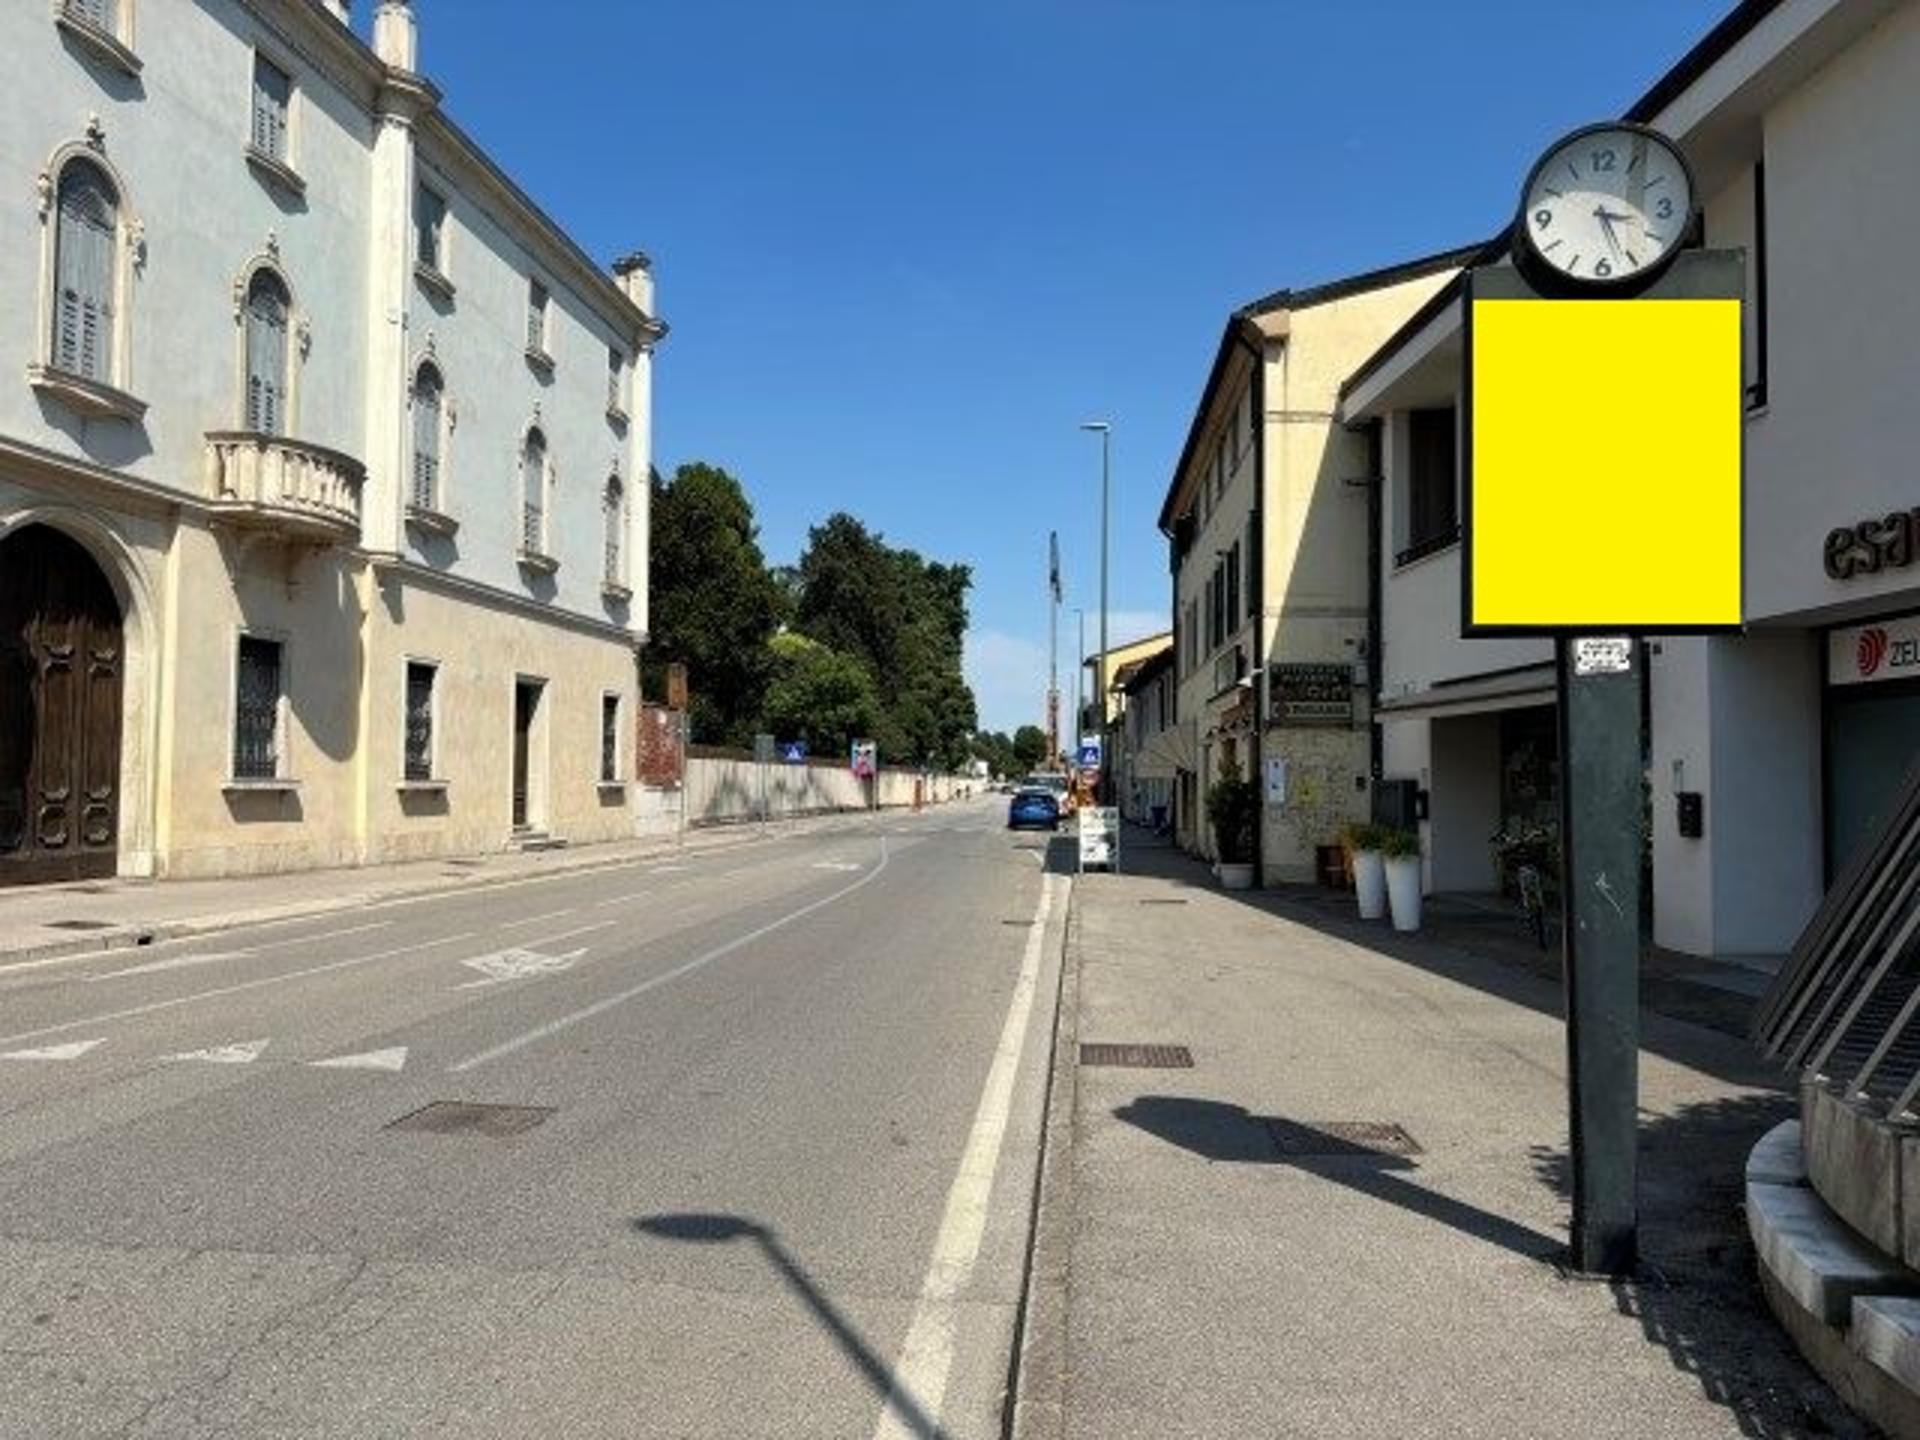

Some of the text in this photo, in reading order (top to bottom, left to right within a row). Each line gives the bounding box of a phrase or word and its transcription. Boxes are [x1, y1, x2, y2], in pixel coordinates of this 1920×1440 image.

[1590, 150, 1617, 172] 12
[1656, 197, 1673, 219] 3
[1535, 209, 1552, 231] 9
[1595, 257, 1612, 277] 6
